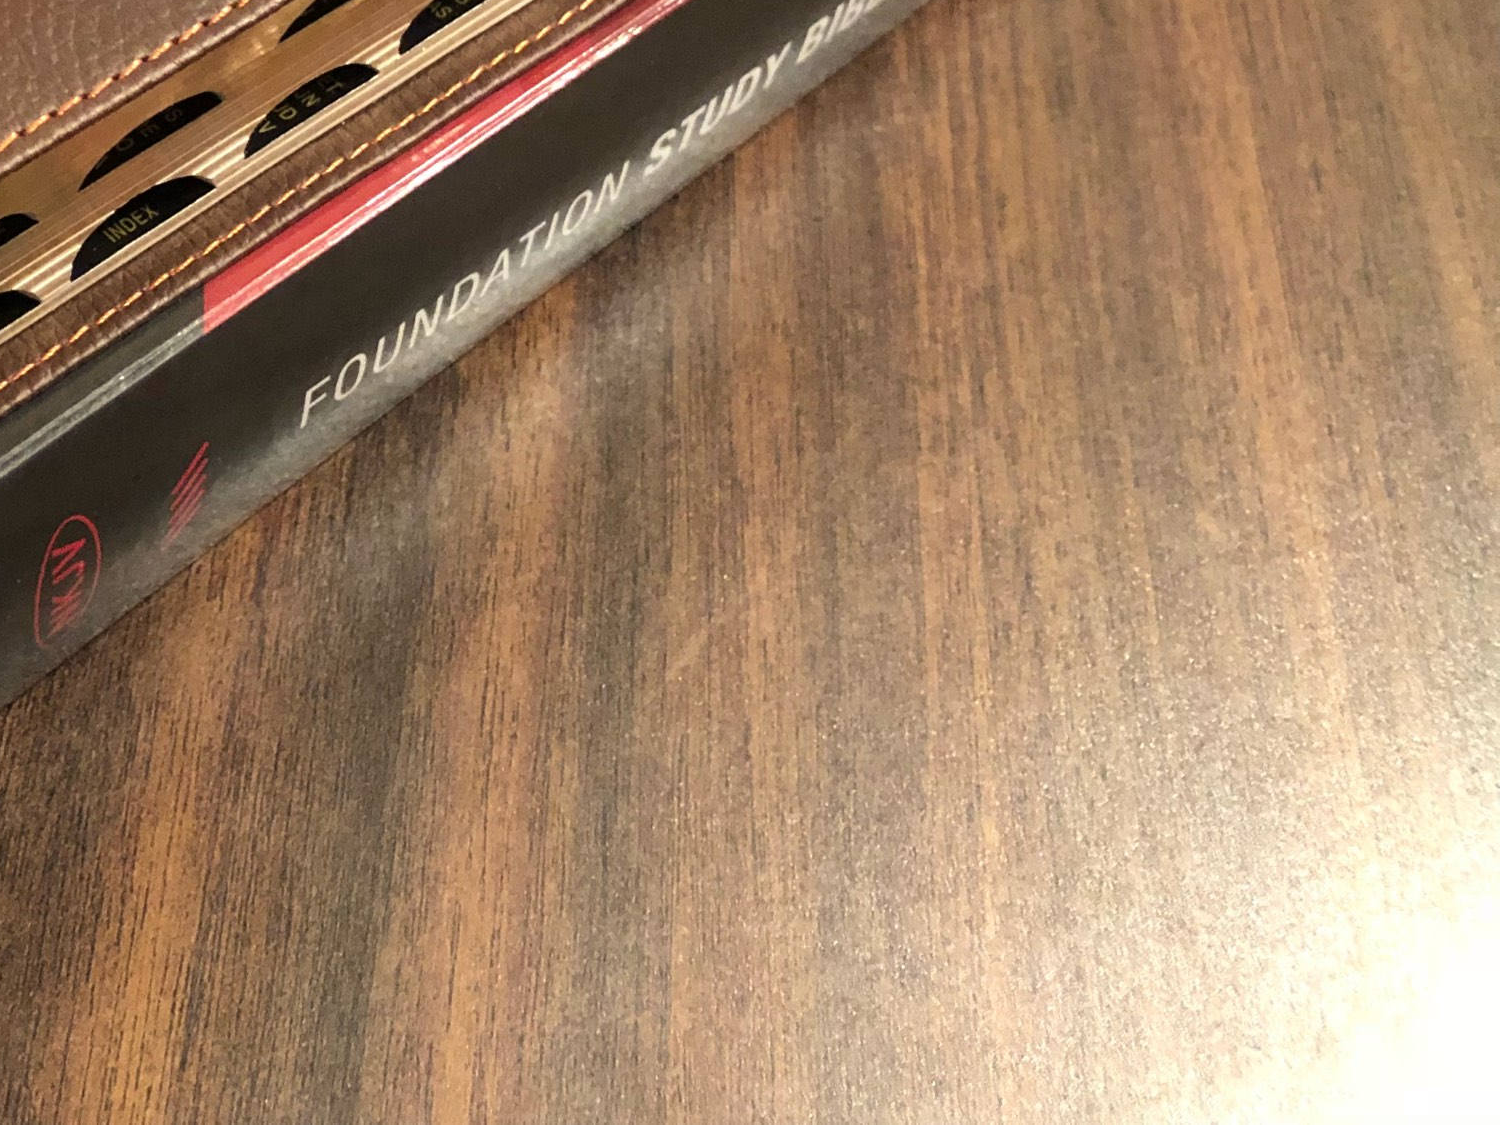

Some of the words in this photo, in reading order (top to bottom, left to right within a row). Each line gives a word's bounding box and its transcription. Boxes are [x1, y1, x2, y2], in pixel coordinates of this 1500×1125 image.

[102, 204, 160, 244] INDEX
[299, 160, 629, 430] FOUNDATION
[643, 41, 795, 177] STUDY
